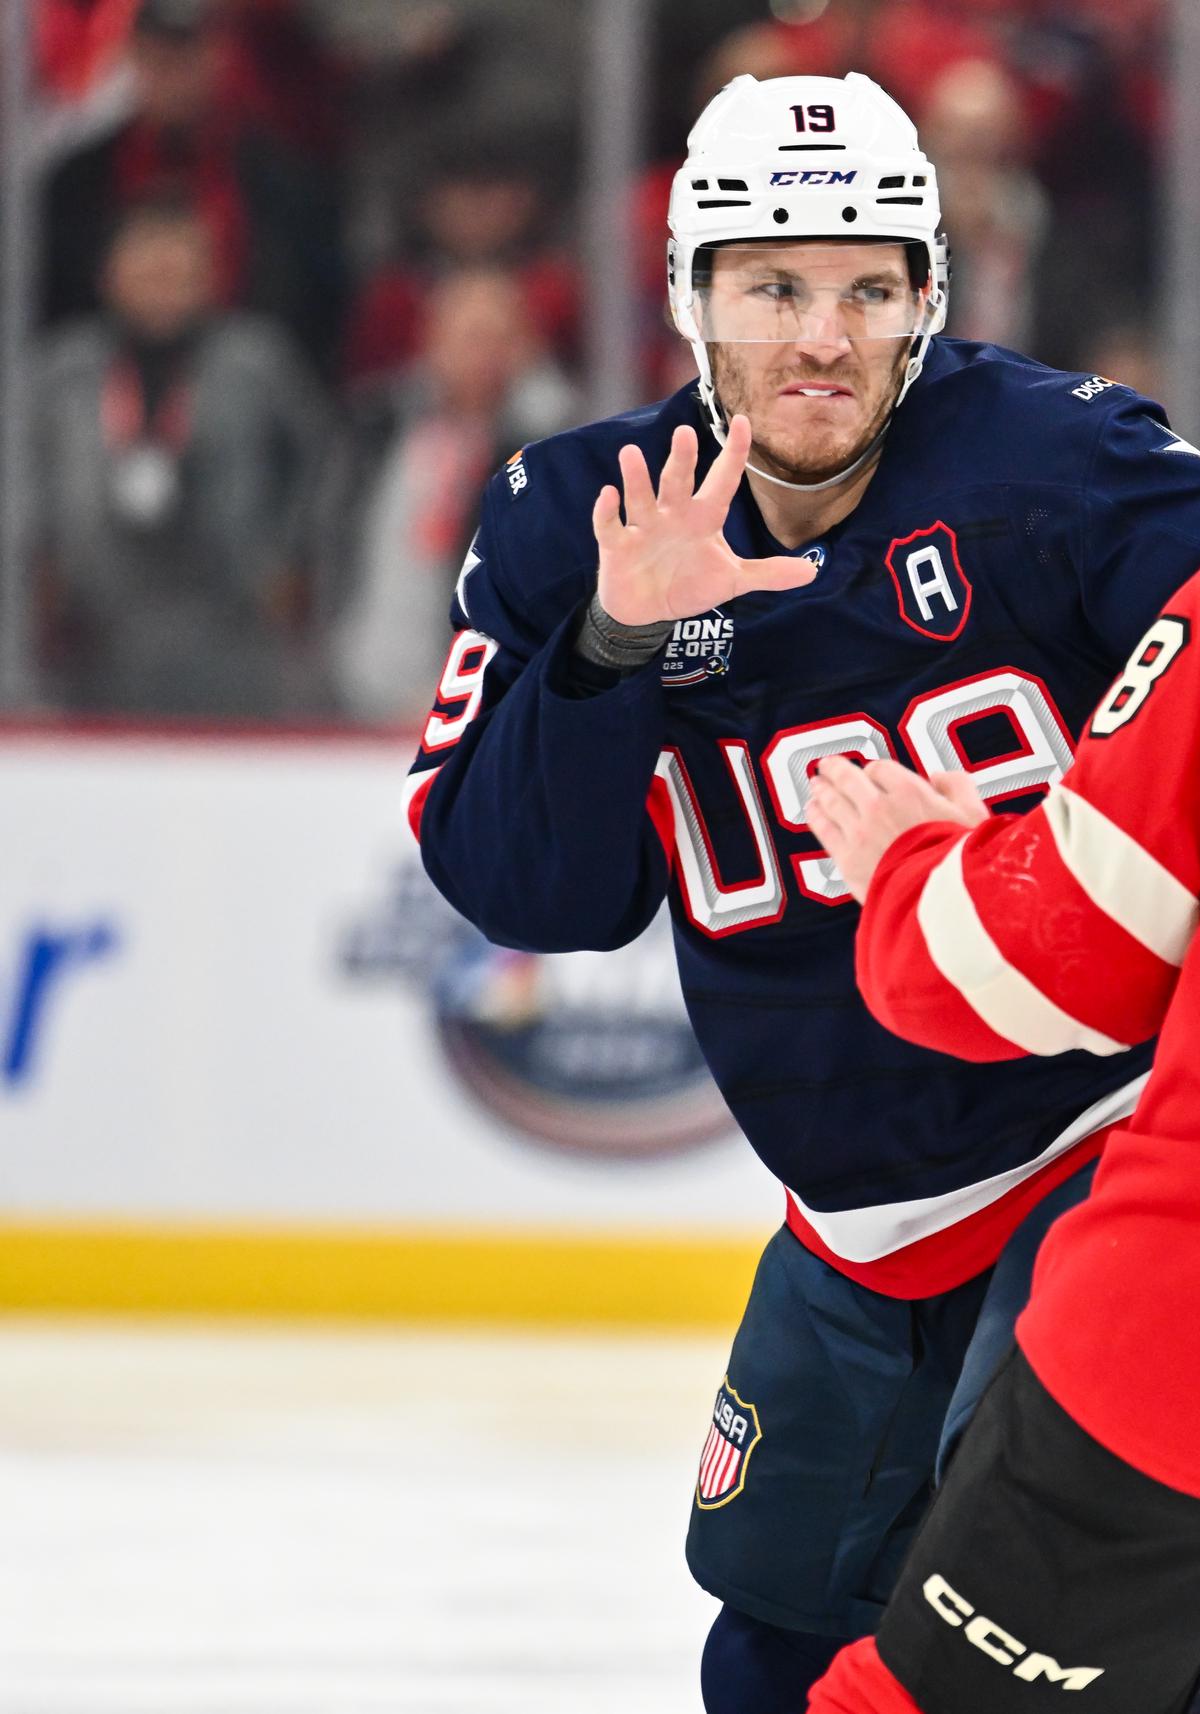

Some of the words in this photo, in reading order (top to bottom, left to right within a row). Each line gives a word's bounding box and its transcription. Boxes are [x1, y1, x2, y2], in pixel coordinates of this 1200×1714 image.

[789, 104, 836, 133] 19
[769, 170, 858, 186] CCM
[1071, 376, 1117, 401] DISC
[906, 545, 959, 622] A
[714, 1392, 748, 1446] USA
[923, 1573, 1105, 1691] CCM
